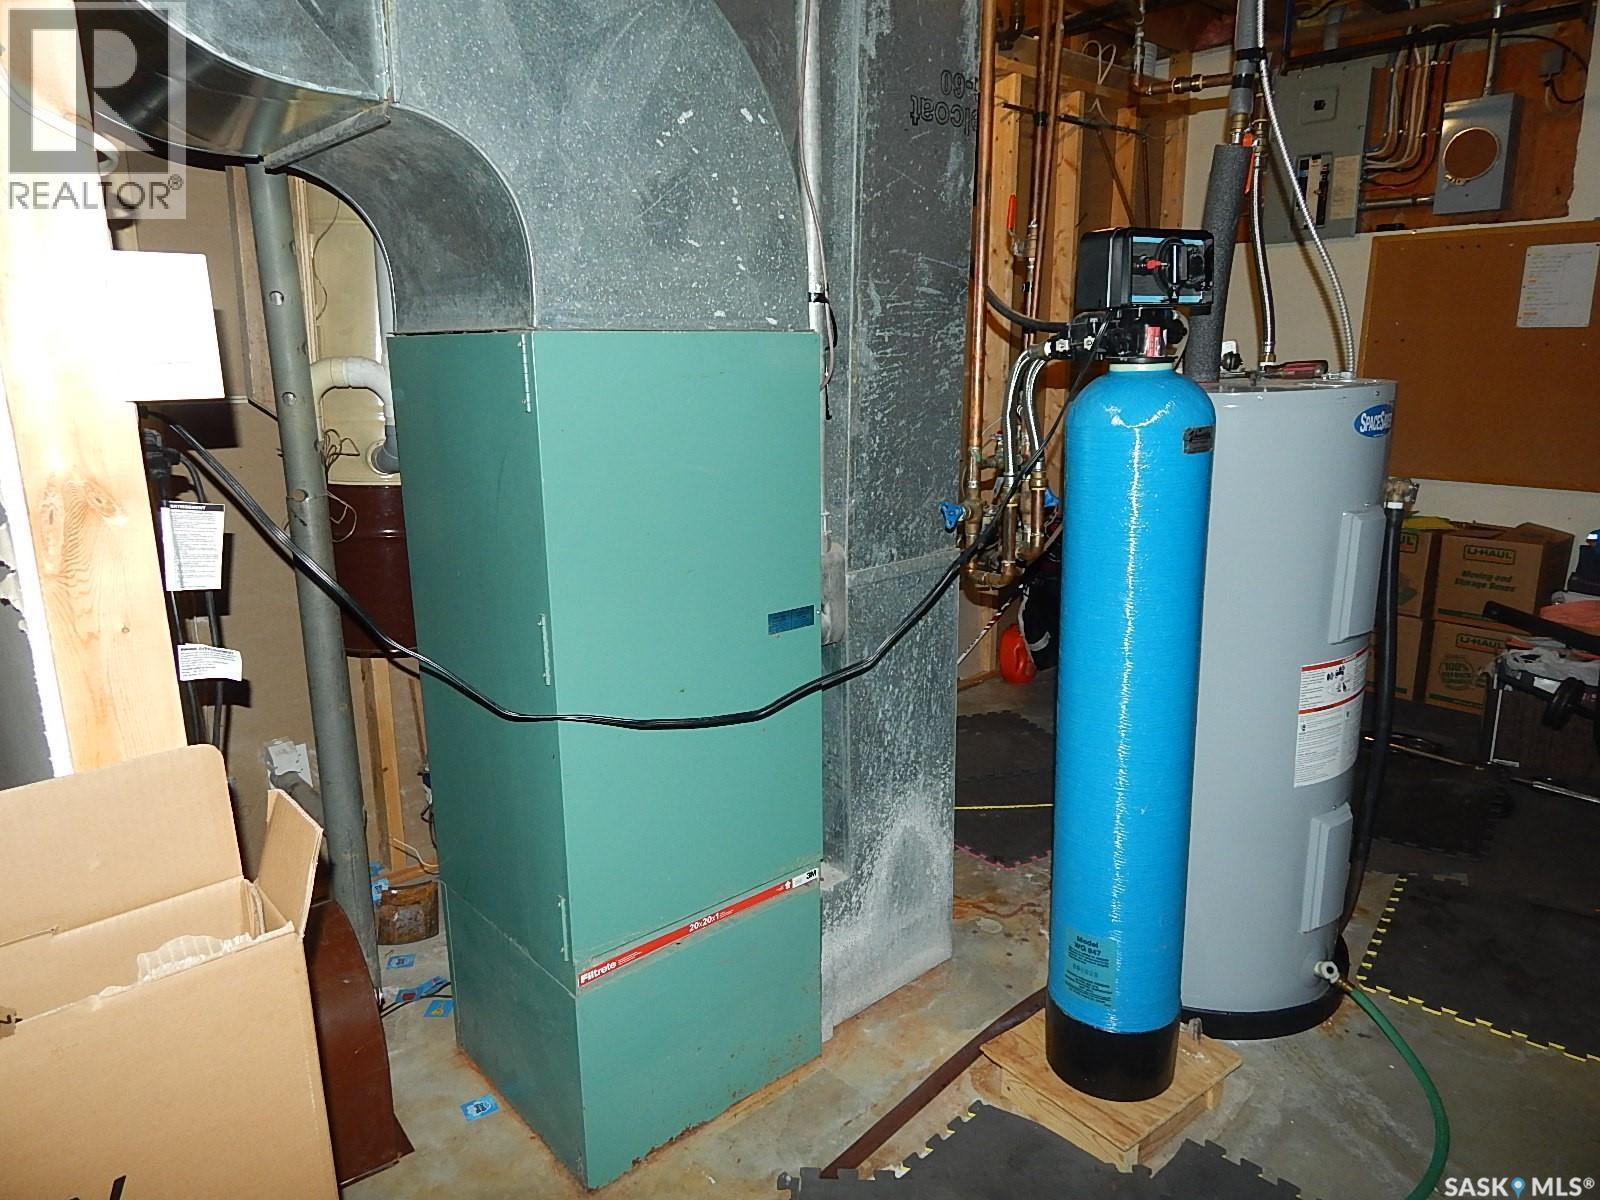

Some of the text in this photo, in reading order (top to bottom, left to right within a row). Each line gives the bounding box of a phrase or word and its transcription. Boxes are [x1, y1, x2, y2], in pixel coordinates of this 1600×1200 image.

[1466, 547, 1513, 560] U-HAUL
[806, 869, 817, 880] 3M
[1076, 935, 1099, 949] Model
